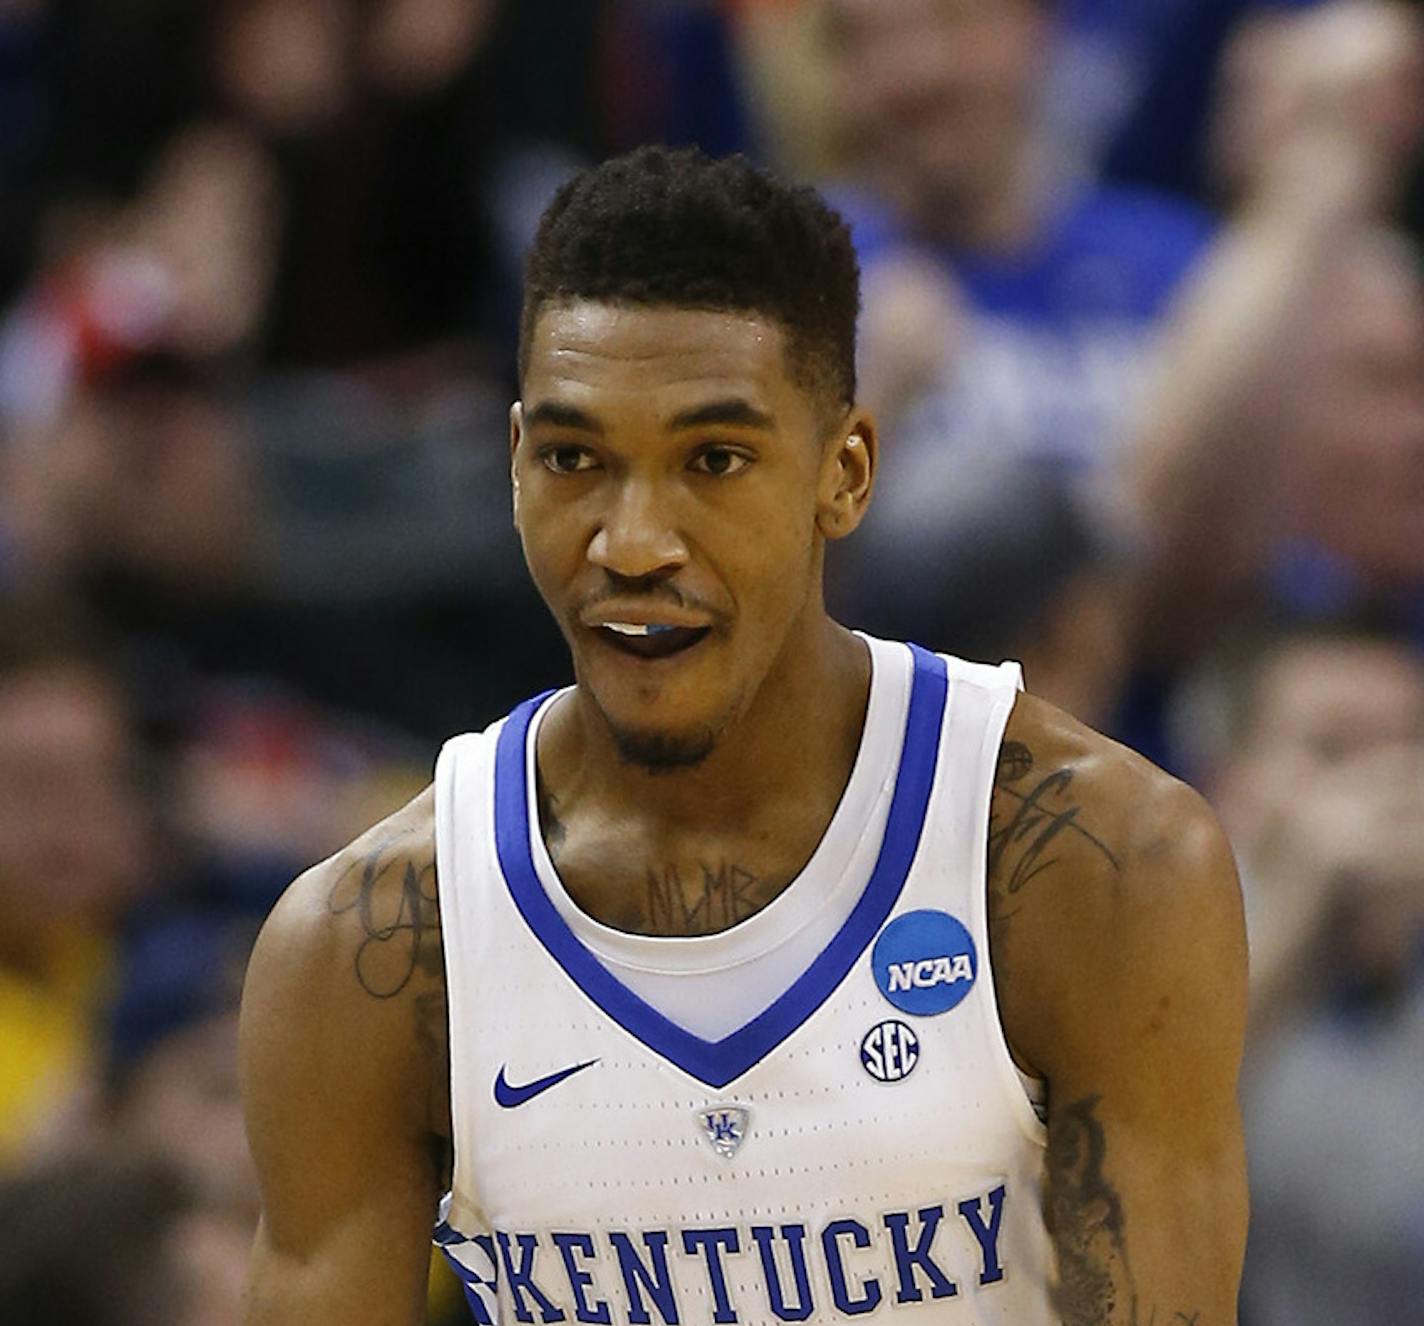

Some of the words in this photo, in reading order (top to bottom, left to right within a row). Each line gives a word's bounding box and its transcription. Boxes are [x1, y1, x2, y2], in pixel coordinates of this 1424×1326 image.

[887, 953, 974, 993] NCAA
[862, 1021, 919, 1081] SEC
[705, 1112, 740, 1141] UK
[497, 1184, 1007, 1326] KENTUCKY
